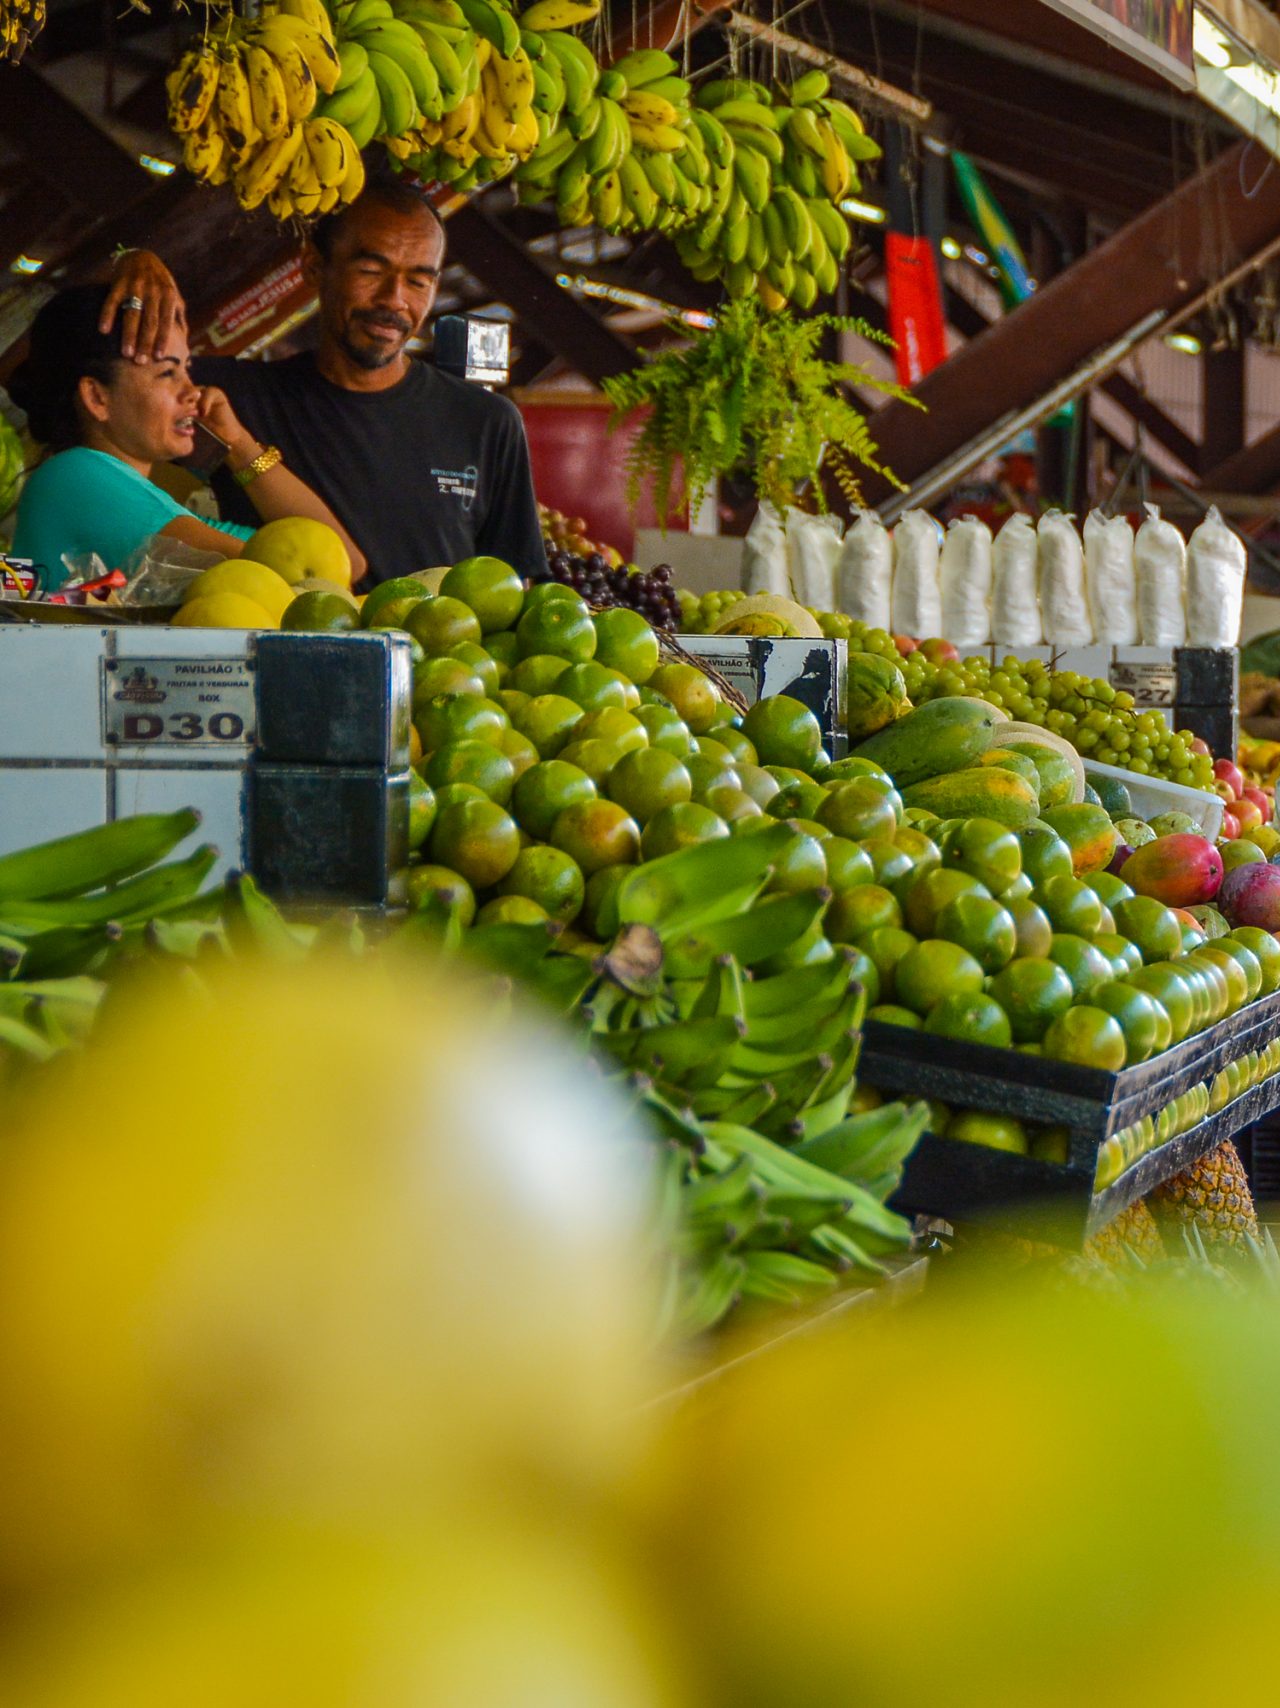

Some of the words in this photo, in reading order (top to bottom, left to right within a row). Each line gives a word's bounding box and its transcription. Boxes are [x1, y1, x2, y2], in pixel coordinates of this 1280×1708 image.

[705, 658, 743, 667] AVILHÃO
[175, 663, 233, 674] PAVILHÃO
[166, 680, 197, 688] FRUTAS
[198, 693, 221, 702] BOX
[123, 711, 244, 740] D30
